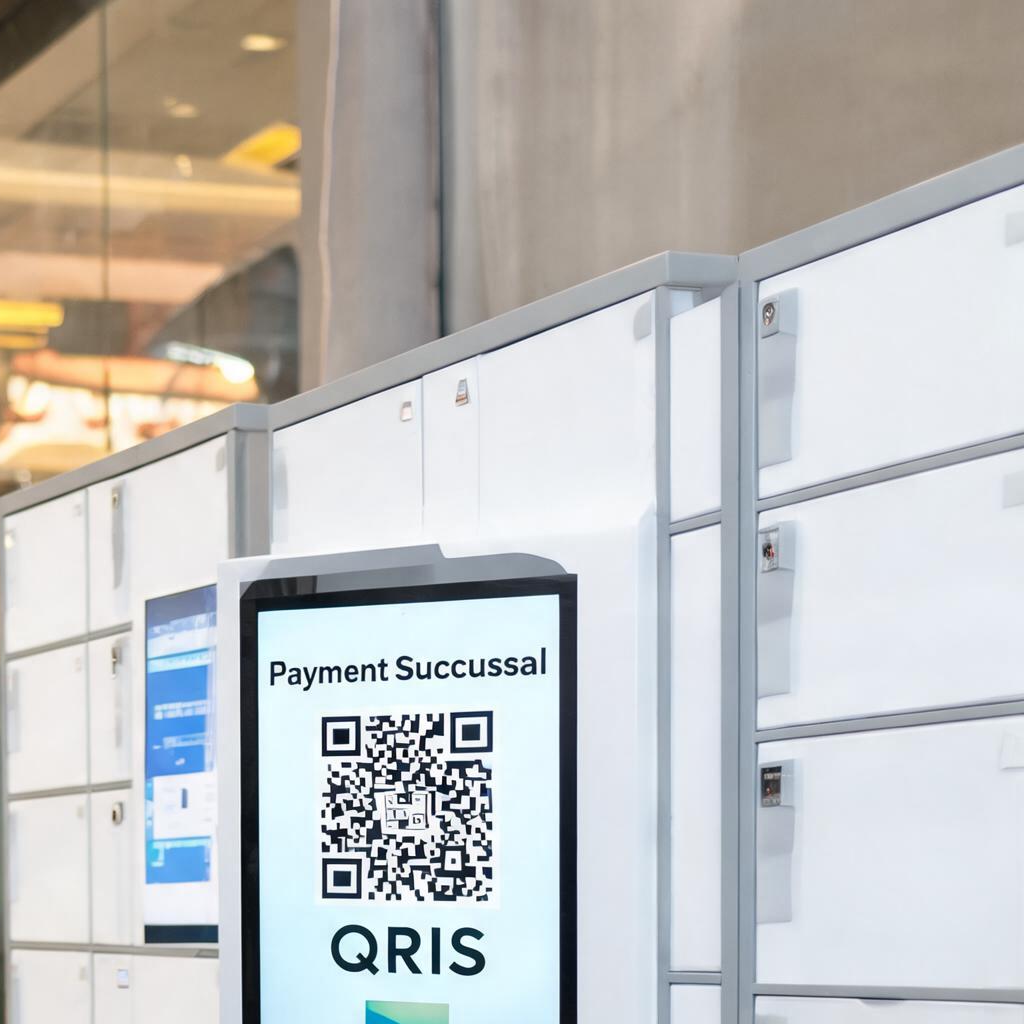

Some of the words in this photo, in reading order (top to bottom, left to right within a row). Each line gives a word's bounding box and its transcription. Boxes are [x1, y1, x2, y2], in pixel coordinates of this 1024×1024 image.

[270, 659, 389, 692] Payment
[395, 647, 547, 681] Succussal
[330, 924, 486, 977] QRIS
